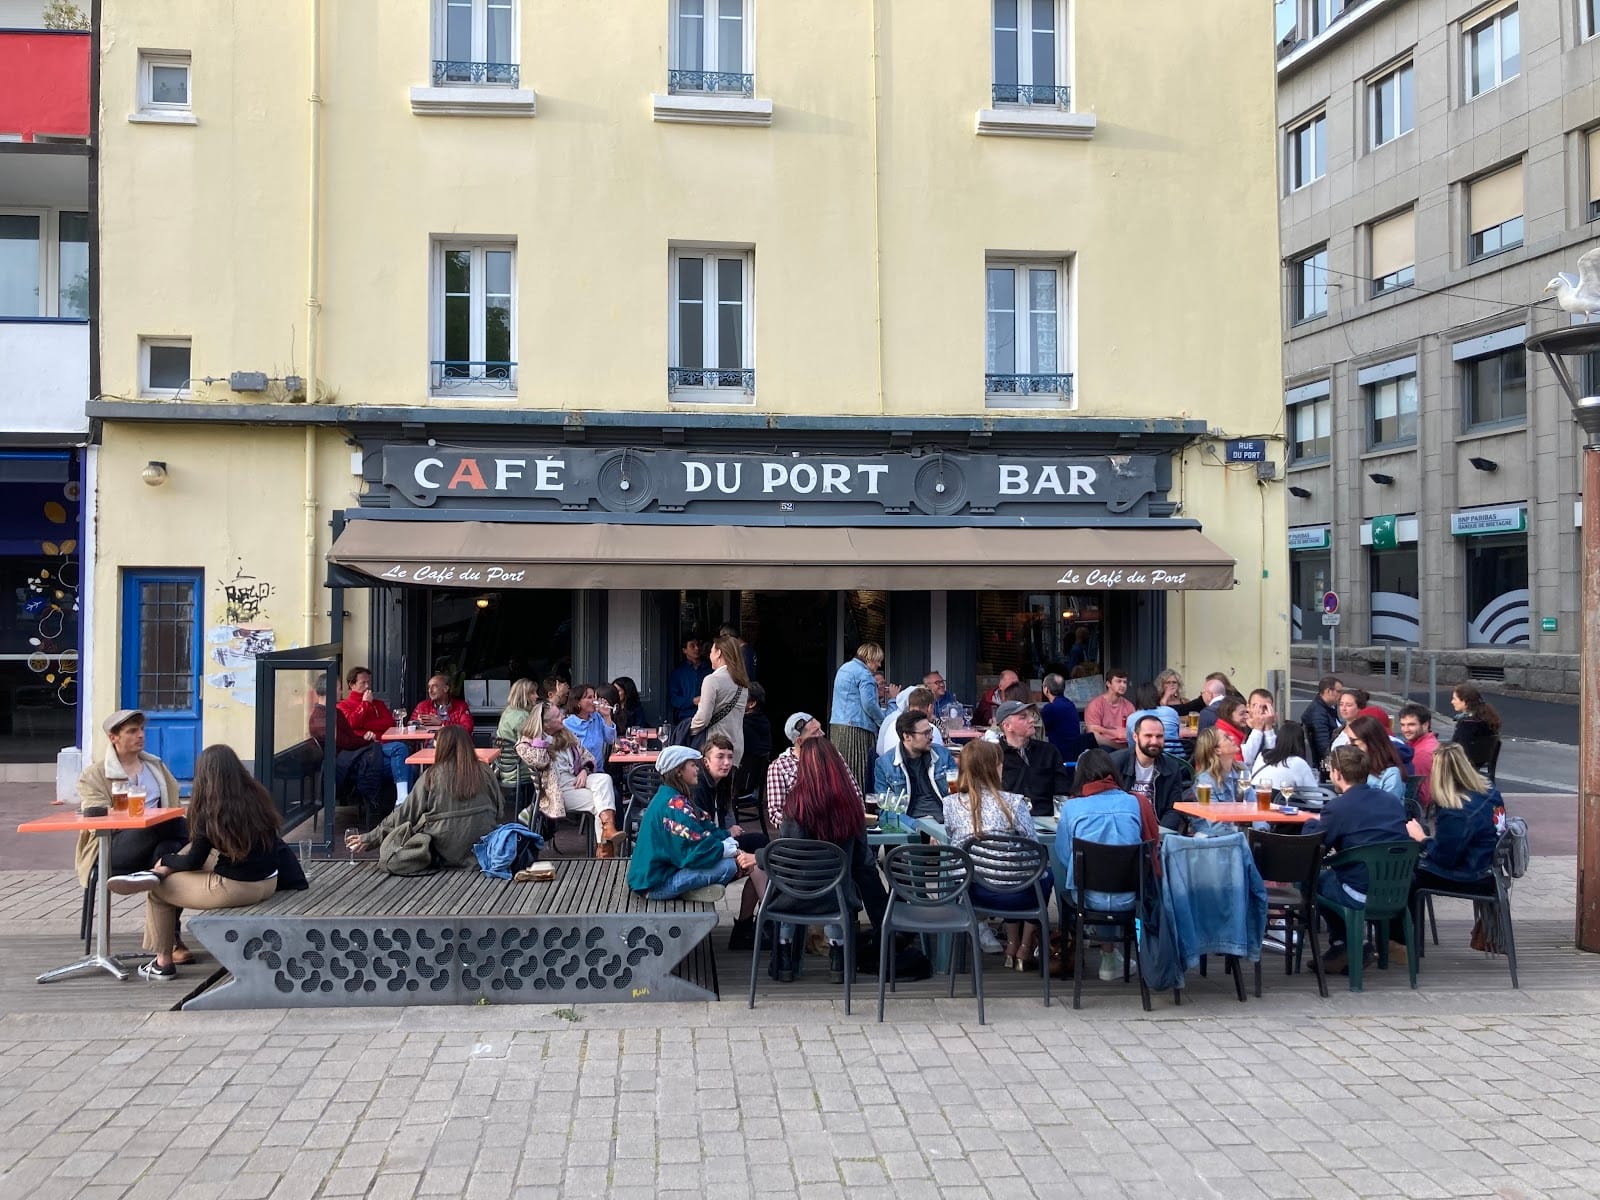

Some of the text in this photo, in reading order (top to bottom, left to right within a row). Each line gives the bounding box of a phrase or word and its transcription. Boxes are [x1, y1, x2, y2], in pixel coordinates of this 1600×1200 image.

[1239, 442, 1254, 450] RUE
[1232, 451, 1261, 459] DU PORT
[413, 455, 1097, 495] CAFÉ DU PORT BAR
[781, 502, 793, 510] 52
[381, 565, 526, 583] Le Café du Port
[1057, 569, 1187, 587] Le Café du Port
